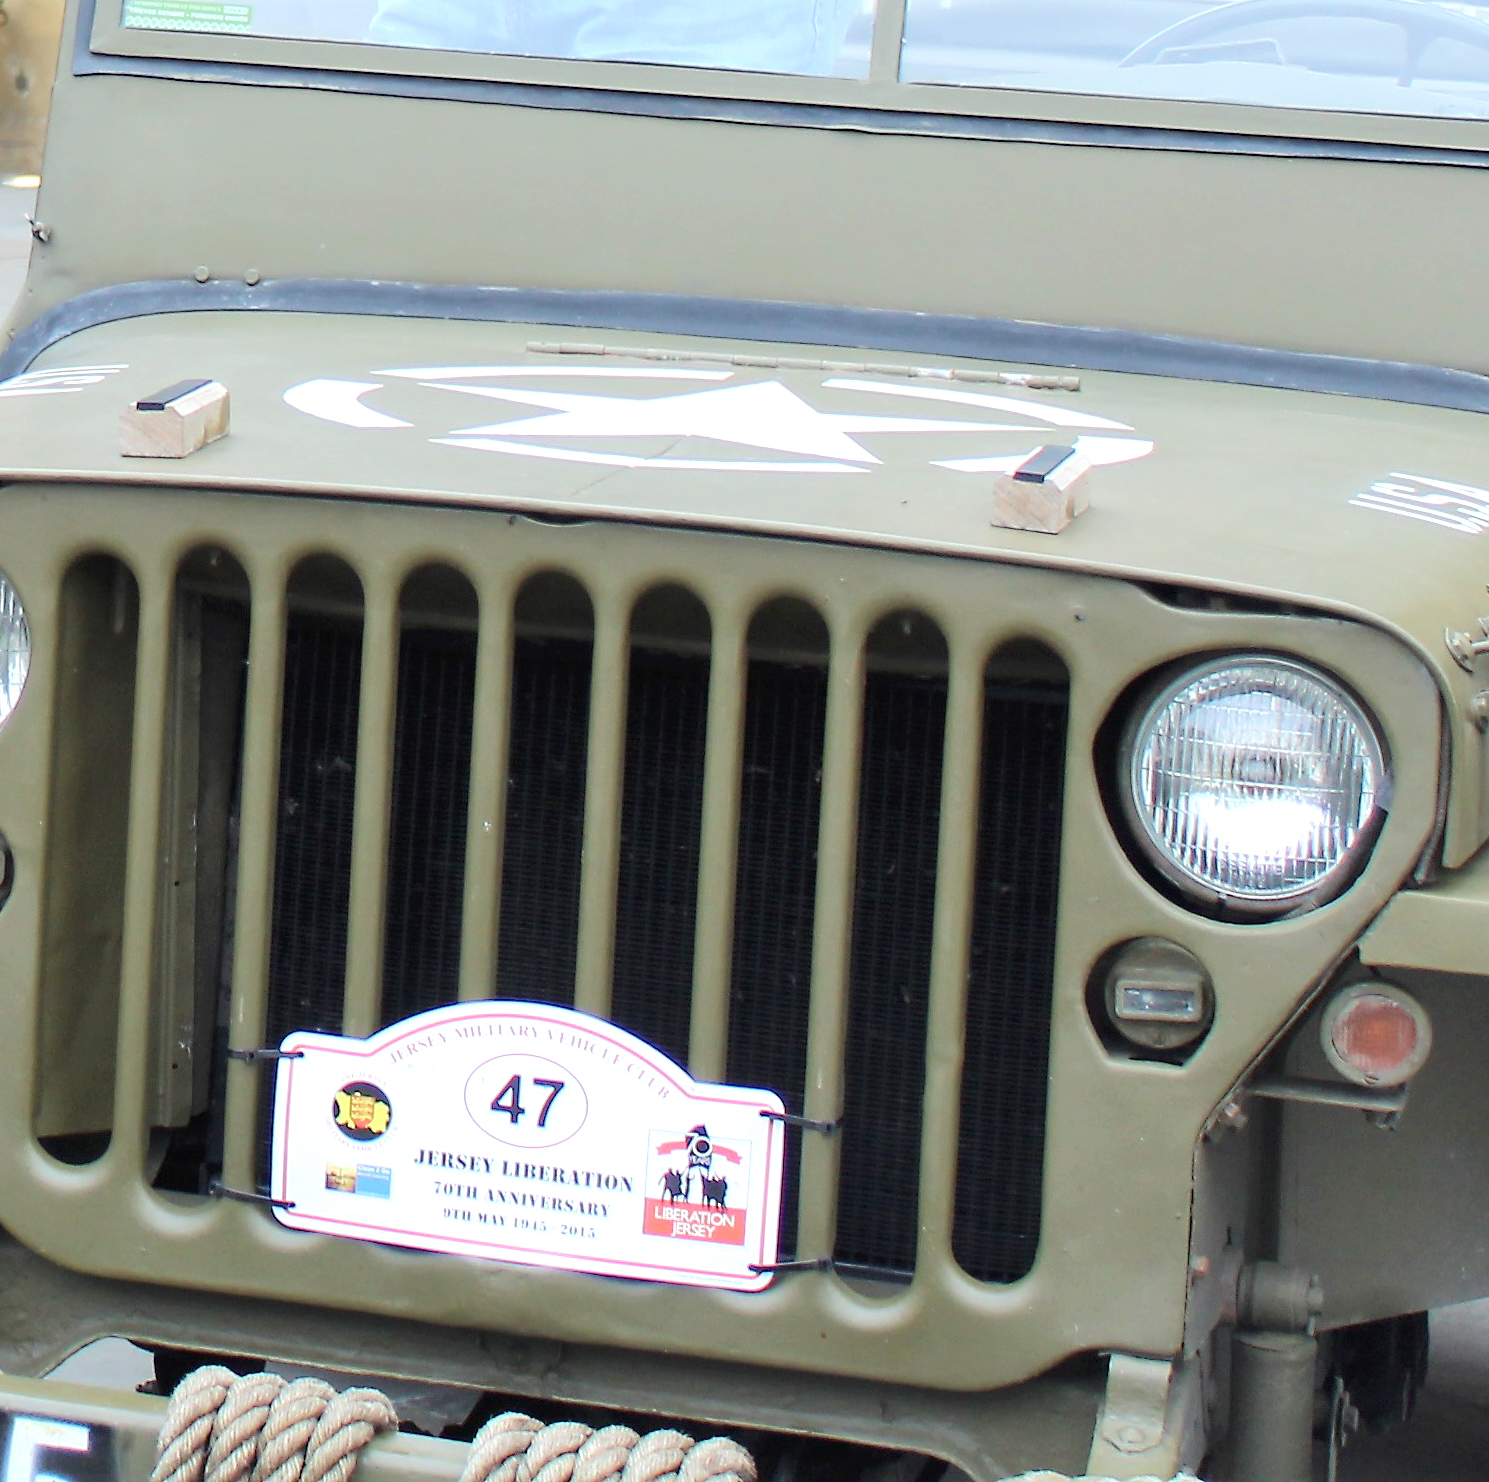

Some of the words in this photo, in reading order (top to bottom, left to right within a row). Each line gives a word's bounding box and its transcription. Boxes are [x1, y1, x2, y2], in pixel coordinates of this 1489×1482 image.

[390, 1029, 448, 1064] JERSEY
[454, 1023, 541, 1039] MILITARY
[547, 1028, 623, 1066] VEHICLE
[626, 1061, 671, 1100] CLUB
[490, 1074, 565, 1128] 47
[414, 1148, 495, 1174] JERSEY
[502, 1159, 635, 1193] LIBERATION
[433, 1180, 478, 1200] 70TH
[485, 1188, 611, 1218] ANNIVERSARY
[653, 1205, 736, 1227] LIBERATION
[442, 1207, 472, 1222] 9TH
[478, 1212, 508, 1227] MAY
[560, 1223, 597, 1239] 2015
[671, 1221, 717, 1239] JERSEY
